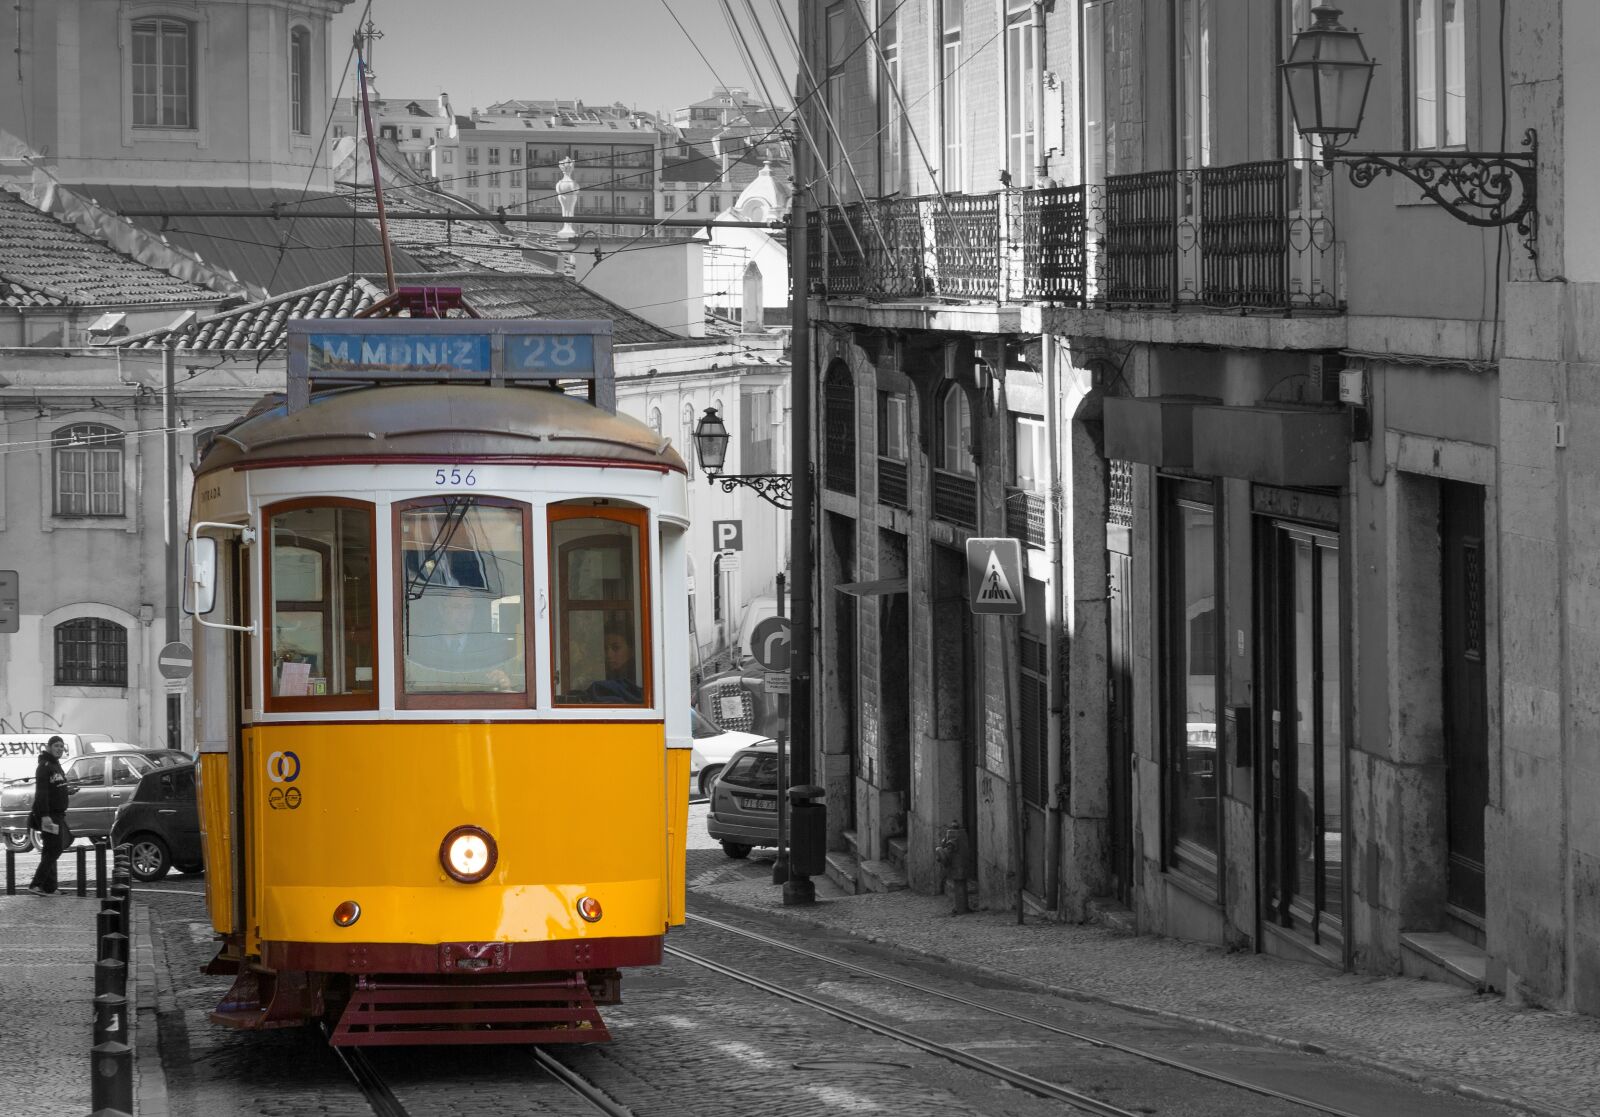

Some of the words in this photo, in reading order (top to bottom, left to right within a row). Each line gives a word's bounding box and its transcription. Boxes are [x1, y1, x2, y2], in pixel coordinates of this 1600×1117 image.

[523, 335, 577, 367] 28
[435, 469, 476, 486] 556
[718, 523, 737, 549] P
